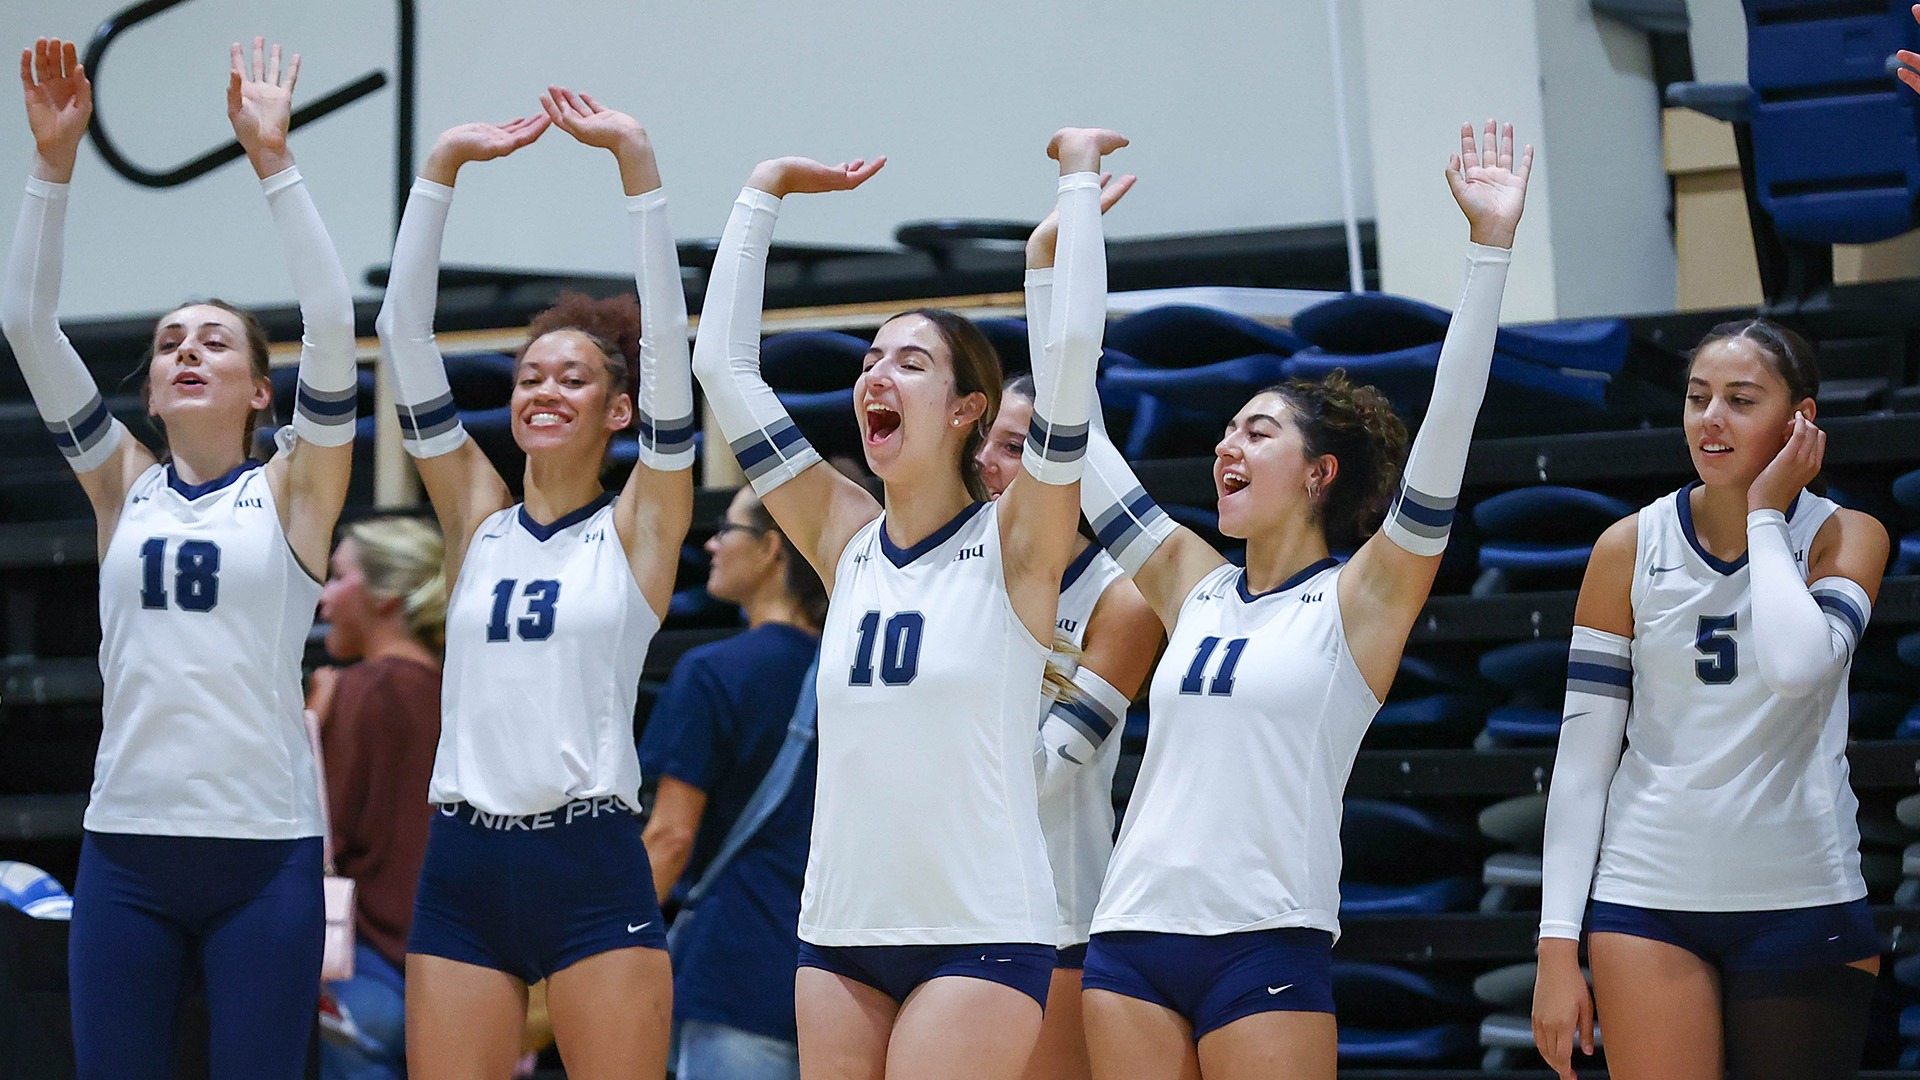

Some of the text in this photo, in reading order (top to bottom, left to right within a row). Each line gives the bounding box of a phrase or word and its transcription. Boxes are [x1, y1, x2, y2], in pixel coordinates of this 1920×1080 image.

[139, 537, 221, 612] 18
[486, 578, 562, 643] 13
[848, 610, 926, 687] 10
[1179, 636, 1250, 697] 11
[1695, 612, 1738, 685] 5
[469, 808, 555, 831] NIKE
